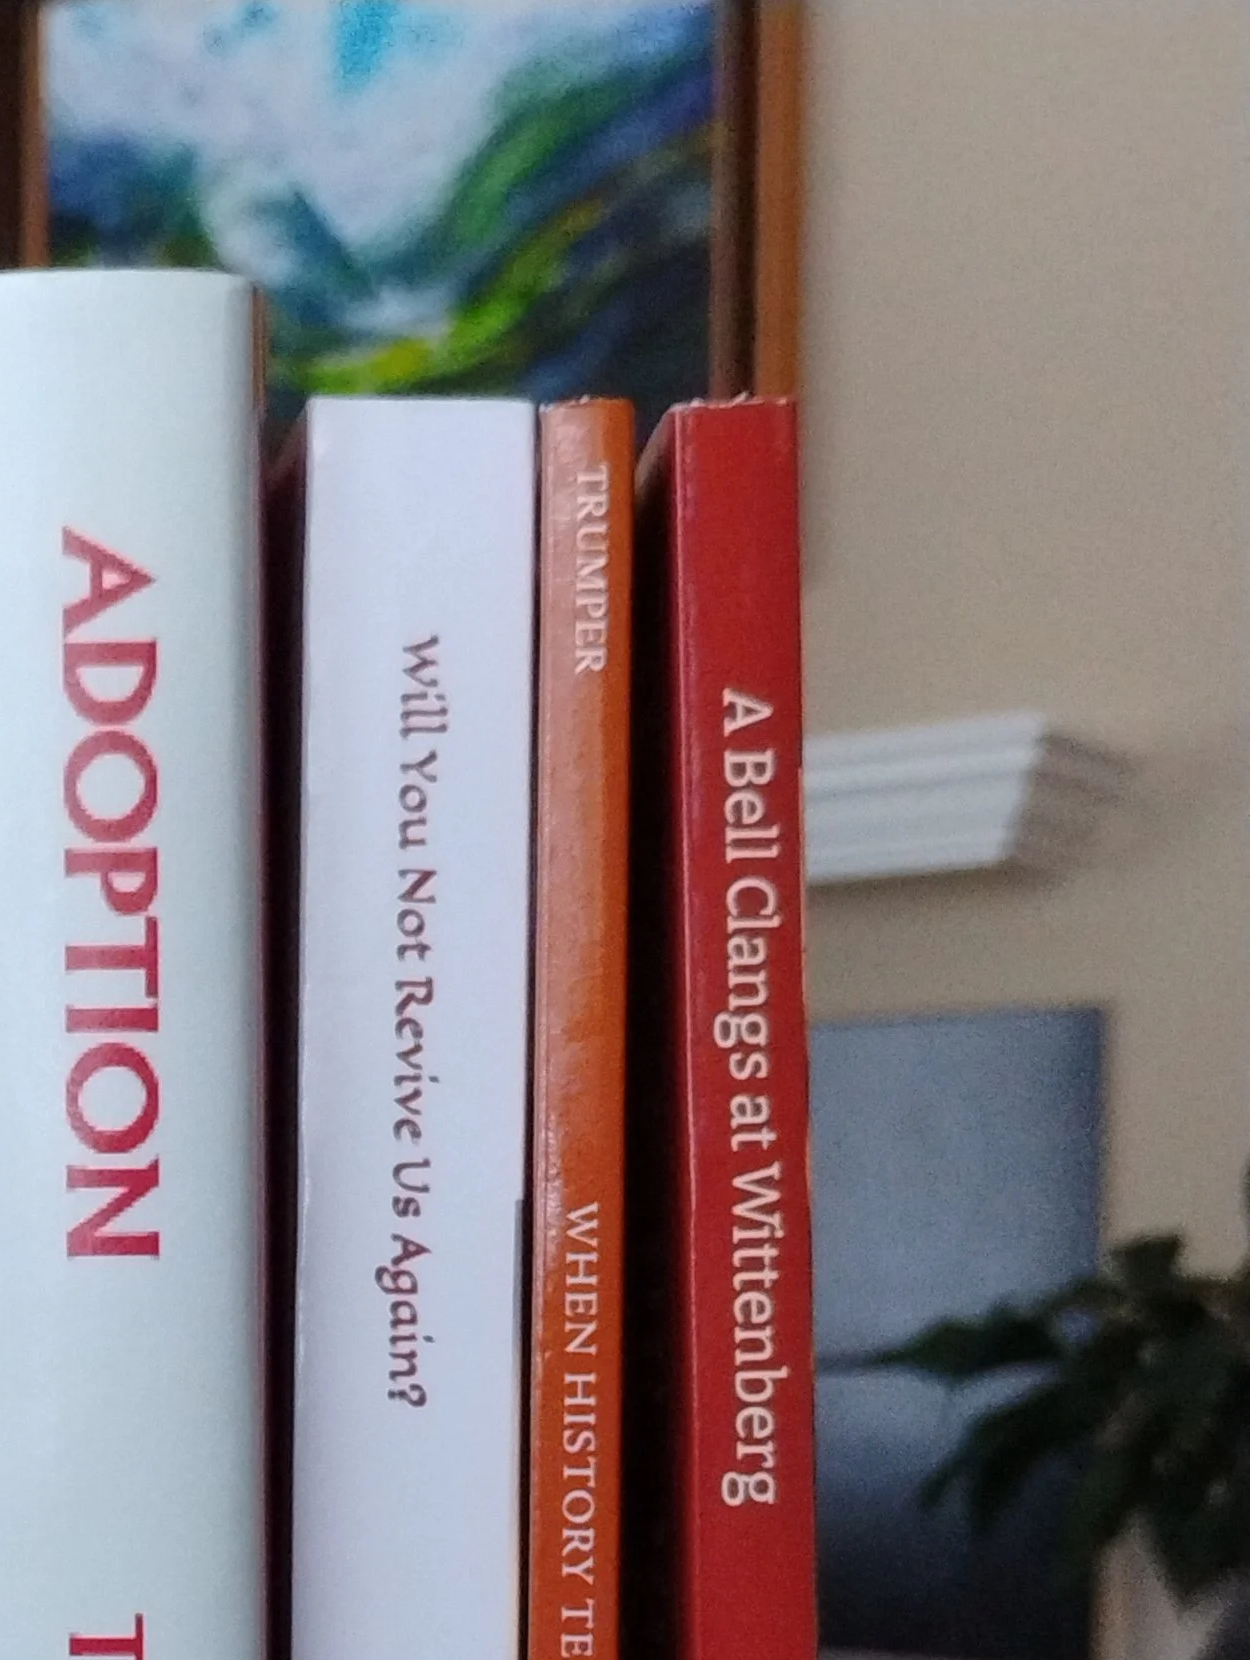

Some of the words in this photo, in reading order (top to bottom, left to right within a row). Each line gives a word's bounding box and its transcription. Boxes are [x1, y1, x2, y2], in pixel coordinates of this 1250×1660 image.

[573, 462, 610, 674] TRUMPER
[399, 633, 449, 740] Will
[722, 687, 774, 738] A
[397, 749, 438, 850] You
[723, 749, 781, 864] Bell
[62, 525, 161, 1262] ADOPTION
[395, 868, 438, 963] Not
[713, 876, 783, 1081] Clangs
[391, 976, 440, 1145] Revive
[729, 1094, 778, 1152] at
[390, 1157, 432, 1219] Us
[374, 1232, 435, 1408] Again?
[563, 1202, 599, 1357] WHEN
[720, 1160, 789, 1508] Wittenberg
[561, 1372, 598, 1586] HISTORY
